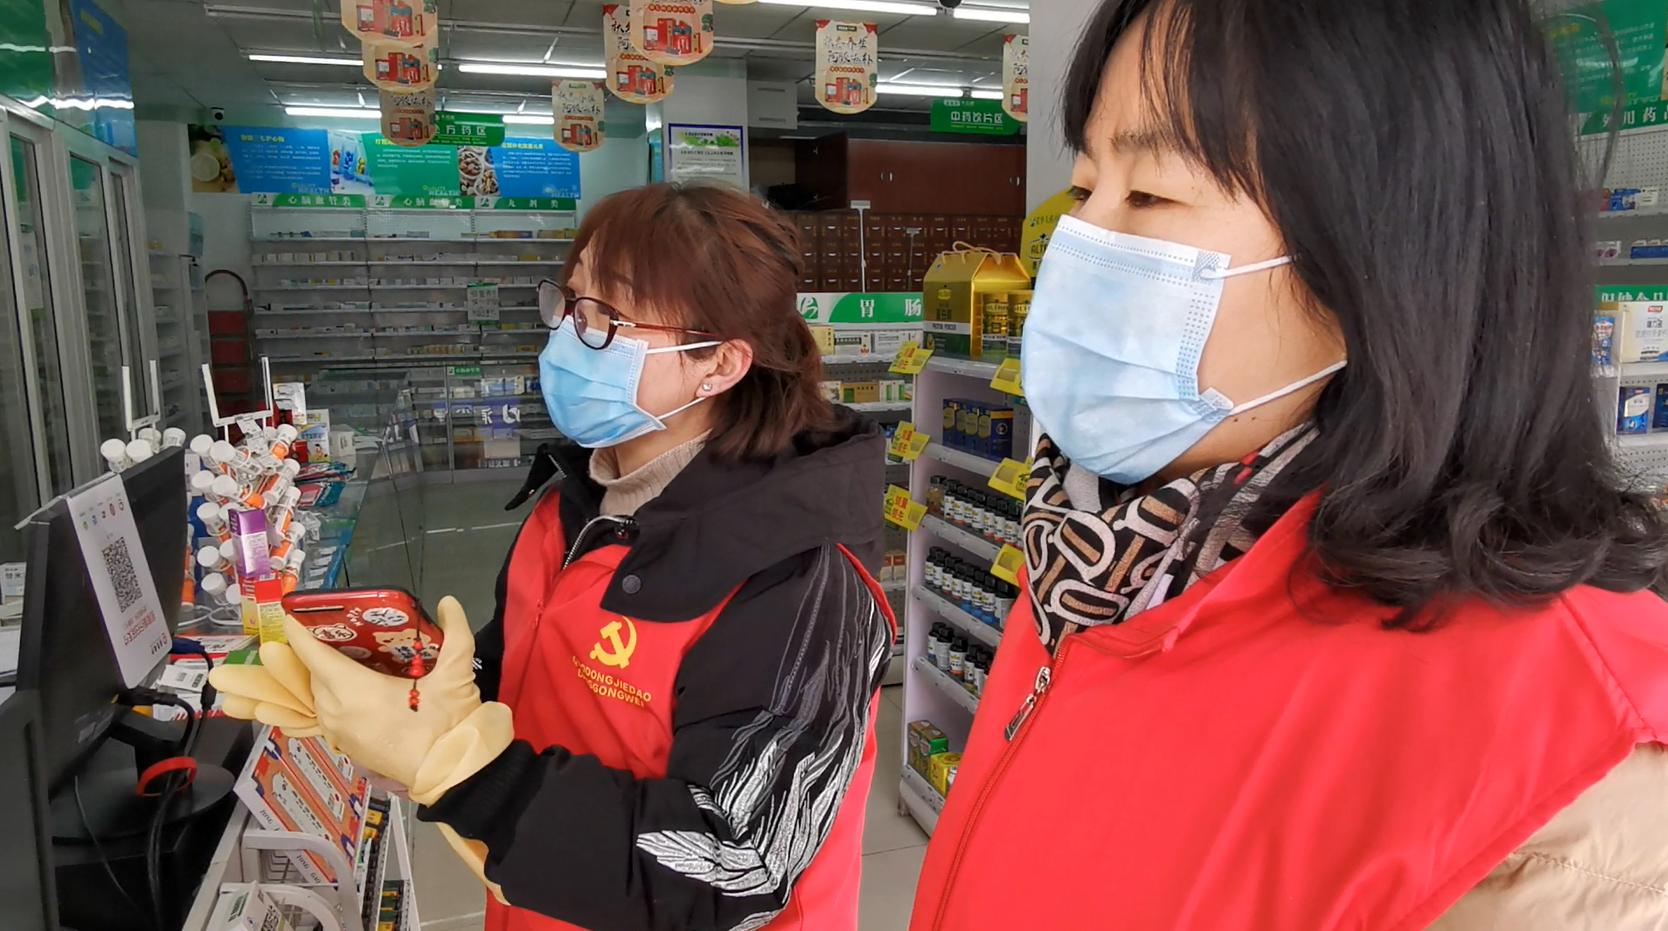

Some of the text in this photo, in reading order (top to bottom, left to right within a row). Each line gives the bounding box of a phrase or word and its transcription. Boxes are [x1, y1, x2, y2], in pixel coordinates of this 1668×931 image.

[950, 111, 1003, 124] 中药饮片区
[860, 298, 922, 319] 胃肠
